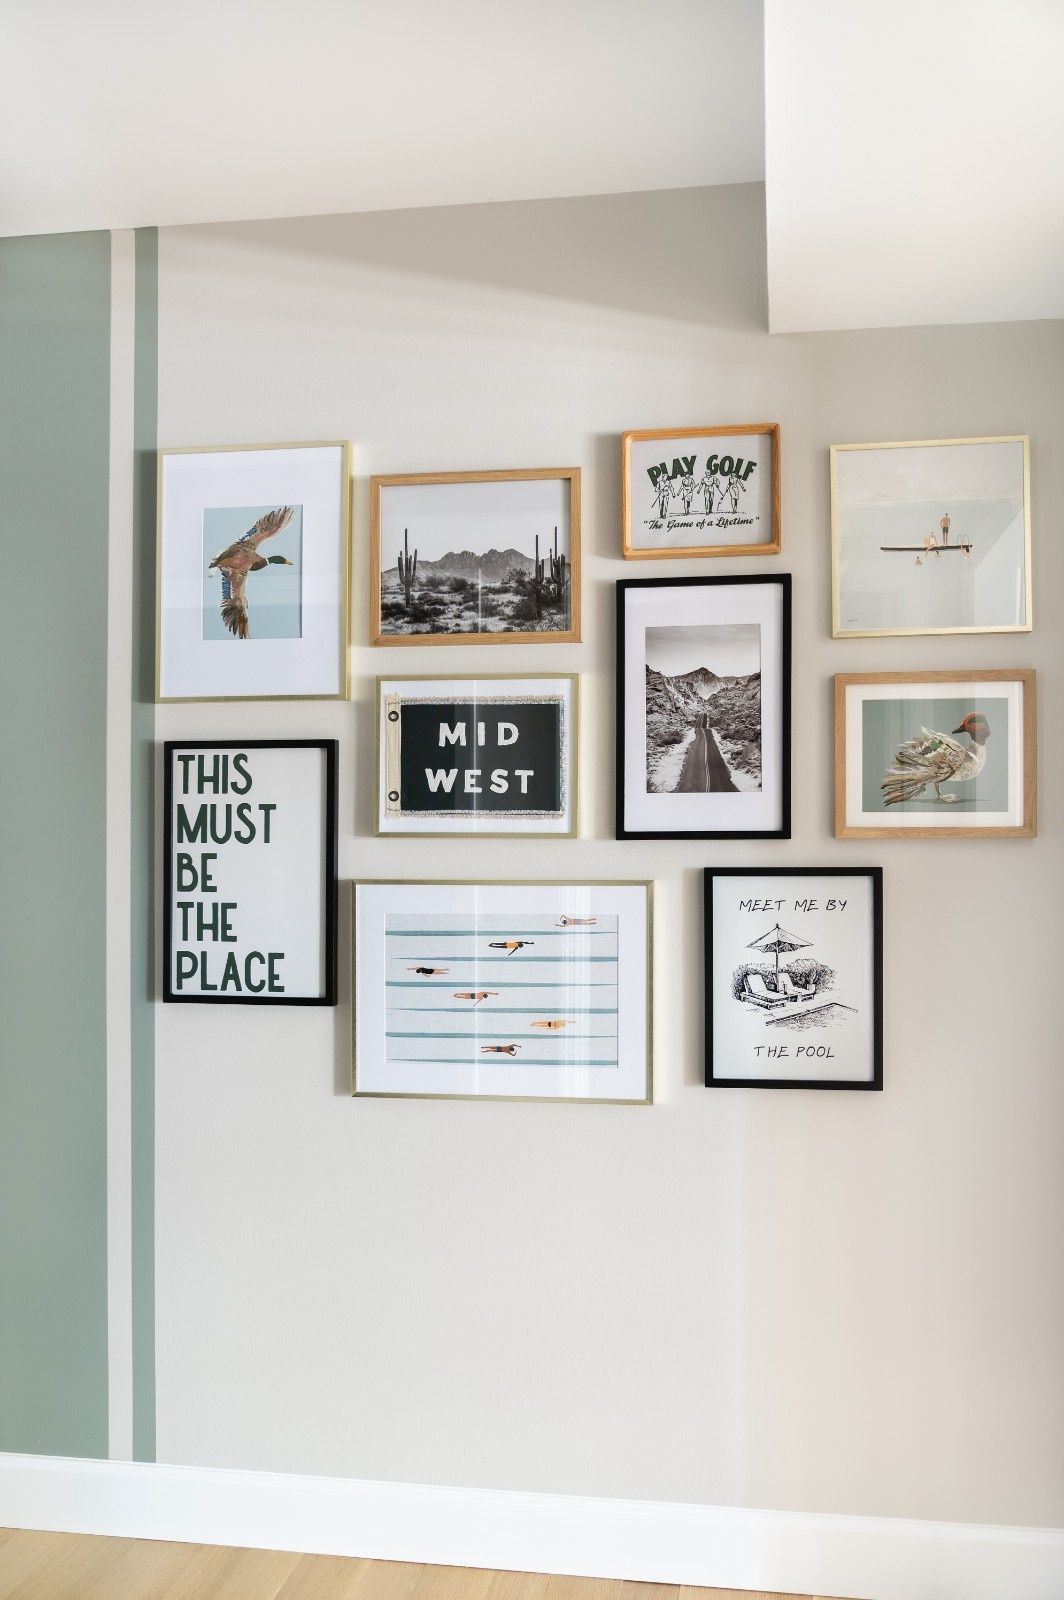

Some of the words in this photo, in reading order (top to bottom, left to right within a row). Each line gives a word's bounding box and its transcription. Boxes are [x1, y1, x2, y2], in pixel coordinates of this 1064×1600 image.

[647, 455, 697, 488] PLAY
[706, 454, 758, 482] GOLF
[667, 519, 693, 532] Game
[695, 518, 706, 530] of
[438, 721, 519, 747] MID
[177, 753, 253, 795] THIS
[424, 768, 534, 794] WEST
[177, 802, 277, 844] MUST
[176, 852, 218, 893] BE
[176, 901, 238, 943] THE
[739, 899, 786, 912] MEET
[794, 899, 818, 912] ME
[825, 899, 848, 911] BY
[176, 950, 285, 993] PLACE
[753, 1046, 790, 1059] THE
[795, 1046, 835, 1059] POOL
